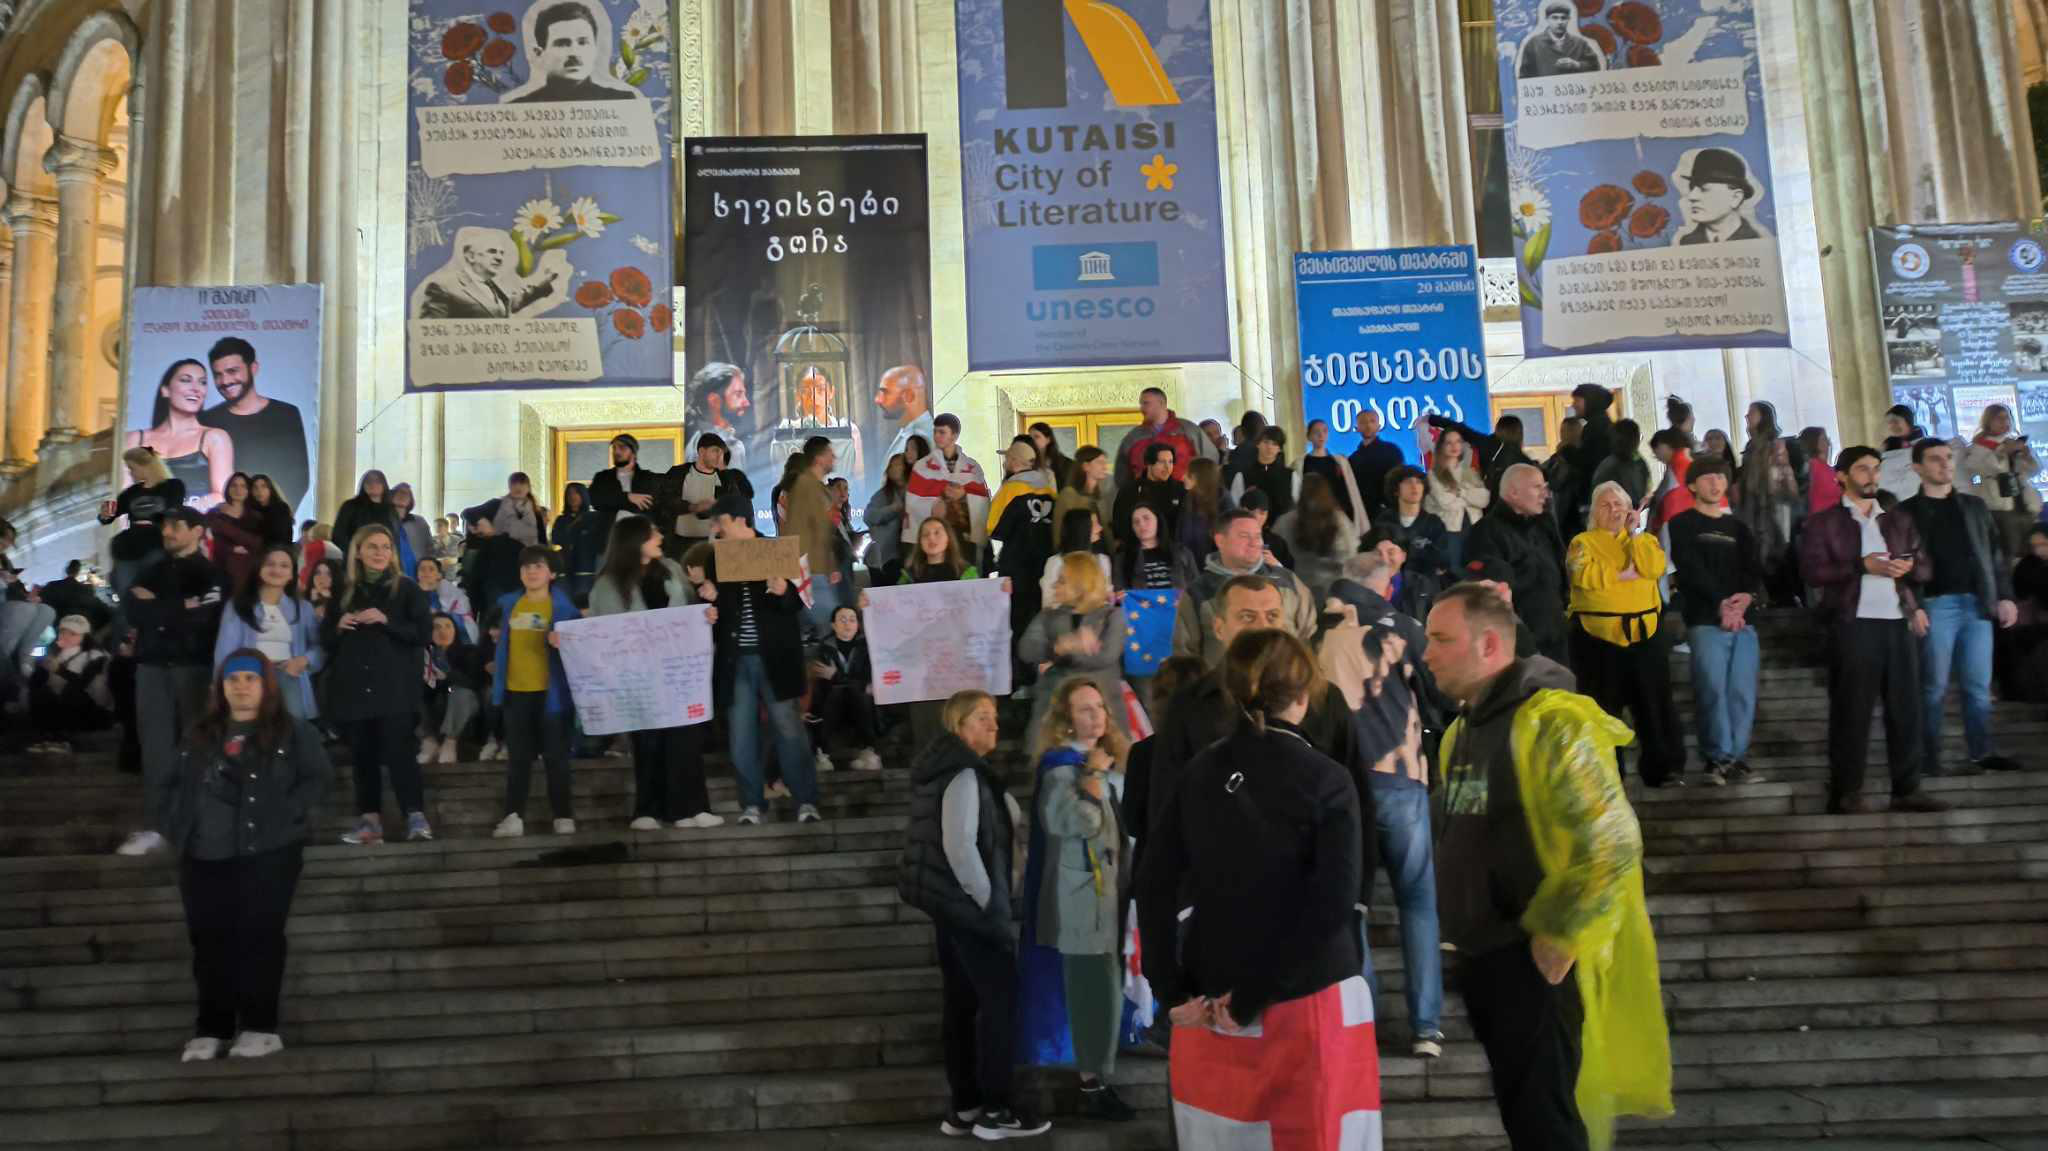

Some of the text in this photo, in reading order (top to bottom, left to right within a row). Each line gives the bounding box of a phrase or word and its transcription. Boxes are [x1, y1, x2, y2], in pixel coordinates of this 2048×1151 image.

[994, 121, 1176, 154] KUTAISI
[995, 160, 1112, 195] City of
[713, 190, 900, 225] ხევისბერი
[997, 198, 1180, 228] Literature
[767, 227, 849, 262] გოჩა
[1299, 251, 1468, 275] მესხიშვილის თეატრში
[1025, 296, 1155, 321] unesco
[1304, 346, 1483, 387] ჯინსების
